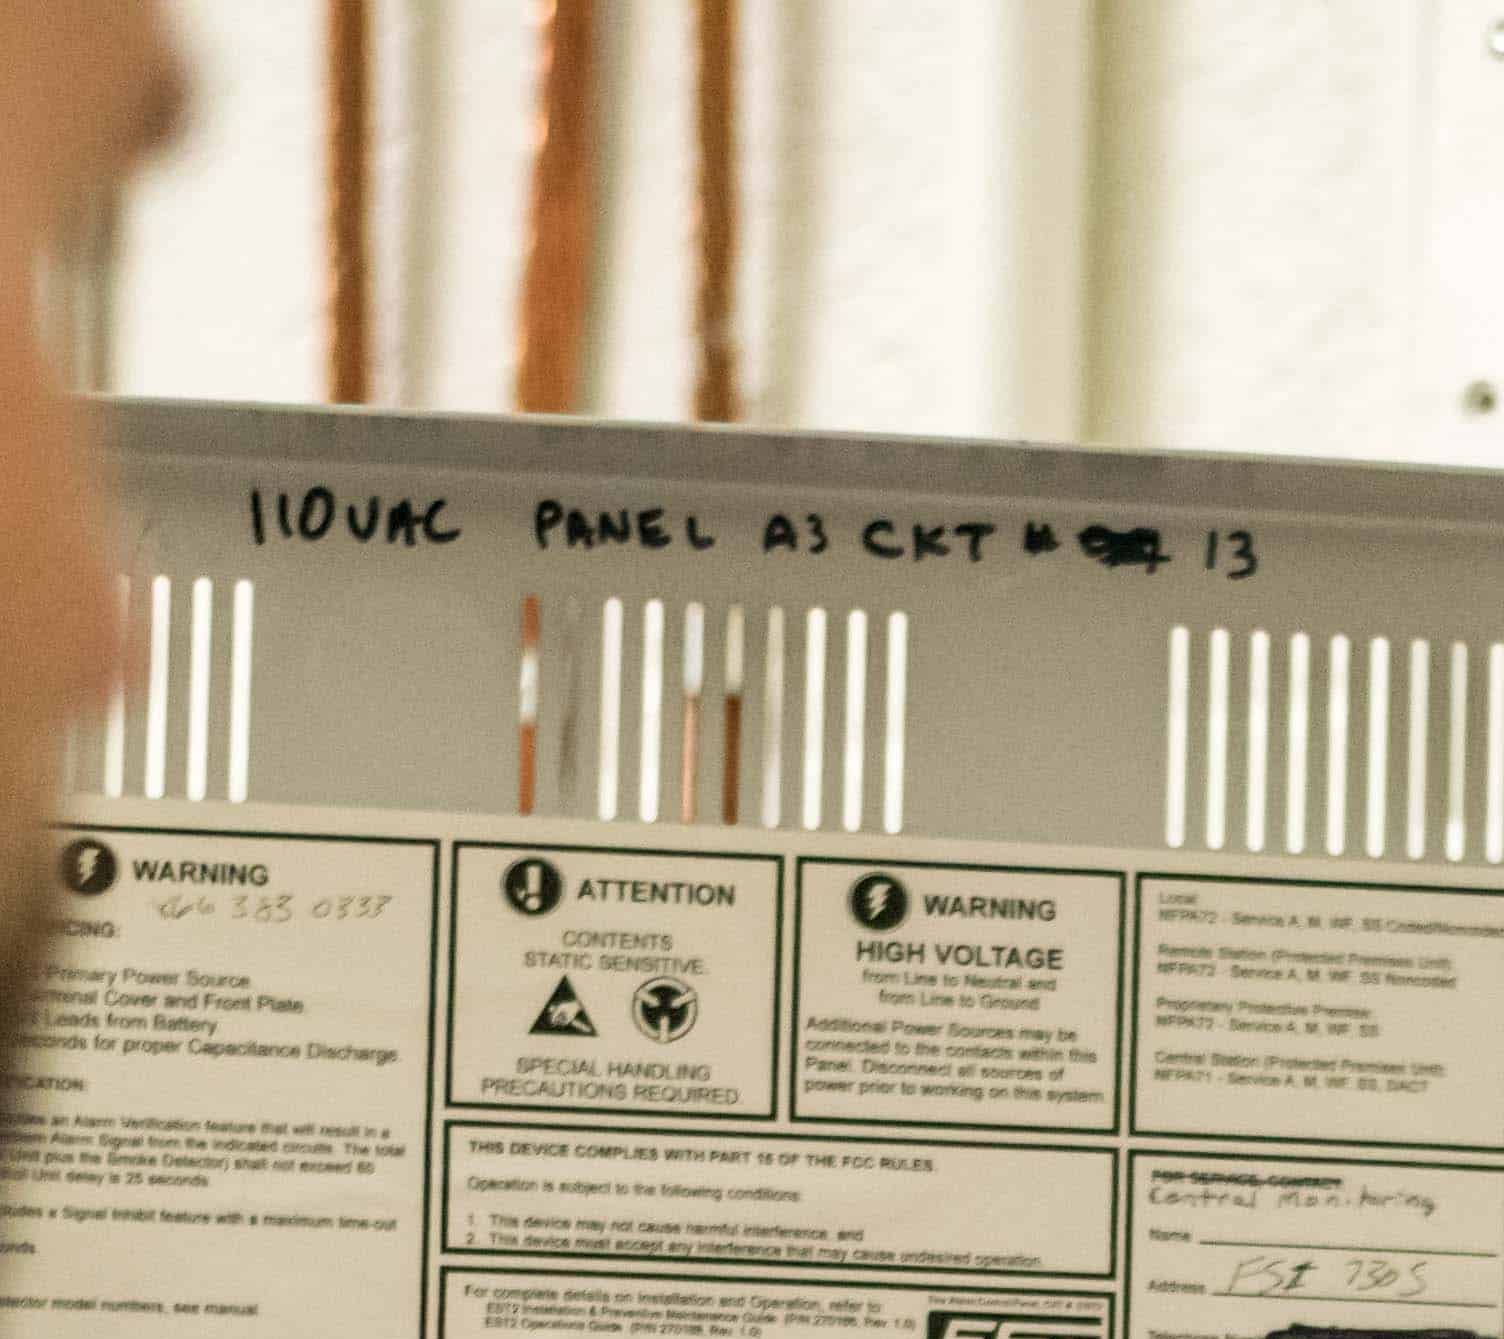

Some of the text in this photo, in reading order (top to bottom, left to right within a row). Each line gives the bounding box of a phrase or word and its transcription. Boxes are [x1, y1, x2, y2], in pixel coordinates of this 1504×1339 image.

[534, 499, 715, 549] PANEL
[763, 513, 827, 554] A3
[862, 518, 996, 561] CKT
[1205, 528, 1258, 580] 13
[132, 859, 269, 886] WARNING
[577, 878, 736, 907] ATTENTION
[923, 894, 1057, 922] WARNING
[562, 930, 673, 951] CONTENTS
[525, 951, 592, 971] STATIC
[856, 941, 1064, 970] HIGH VOLTAGE
[122, 969, 180, 986] Power
[186, 972, 251, 989] Source
[862, 970, 1058, 992] from Line to Neutral and
[104, 992, 158, 1007] Cover
[164, 994, 200, 1009] and
[202, 994, 253, 1011] Front
[878, 990, 917, 1005] from
[919, 992, 956, 1008] Line
[106, 1014, 148, 1029] from
[152, 1016, 218, 1033] Battery
[891, 1021, 942, 1036] Power
[948, 1024, 1016, 1040] Sources
[93, 1036, 117, 1051] for
[122, 1038, 181, 1056] proper
[805, 1038, 891, 1055] connected
[915, 1043, 941, 1057] the
[516, 1057, 711, 1082] SPECIAL HANDLING
[981, 1067, 1044, 1081] sources
[481, 1077, 628, 1100] PRECAUTIONS
[803, 1079, 854, 1093] power
[920, 1083, 986, 1100] working
[470, 1140, 505, 1155] THIS
[509, 1141, 570, 1158] DEVICE
[574, 1144, 659, 1161] COMPLIES
[664, 1147, 707, 1162] WITH
[708, 1149, 751, 1164] PART
[806, 1153, 837, 1168] THE
[842, 1155, 874, 1169] FCC
[467, 1177, 539, 1193] Operation
[559, 1181, 612, 1195] subject
[660, 1184, 724, 1200] following
[491, 1214, 520, 1229] This
[523, 1217, 572, 1230] device
[575, 1219, 607, 1232] may
[611, 1220, 635, 1233] not
[638, 1222, 683, 1235] cause
[491, 1233, 519, 1247] This
[524, 1236, 572, 1250] device
[615, 1239, 664, 1256] accept
[853, 1249, 897, 1262] cause
